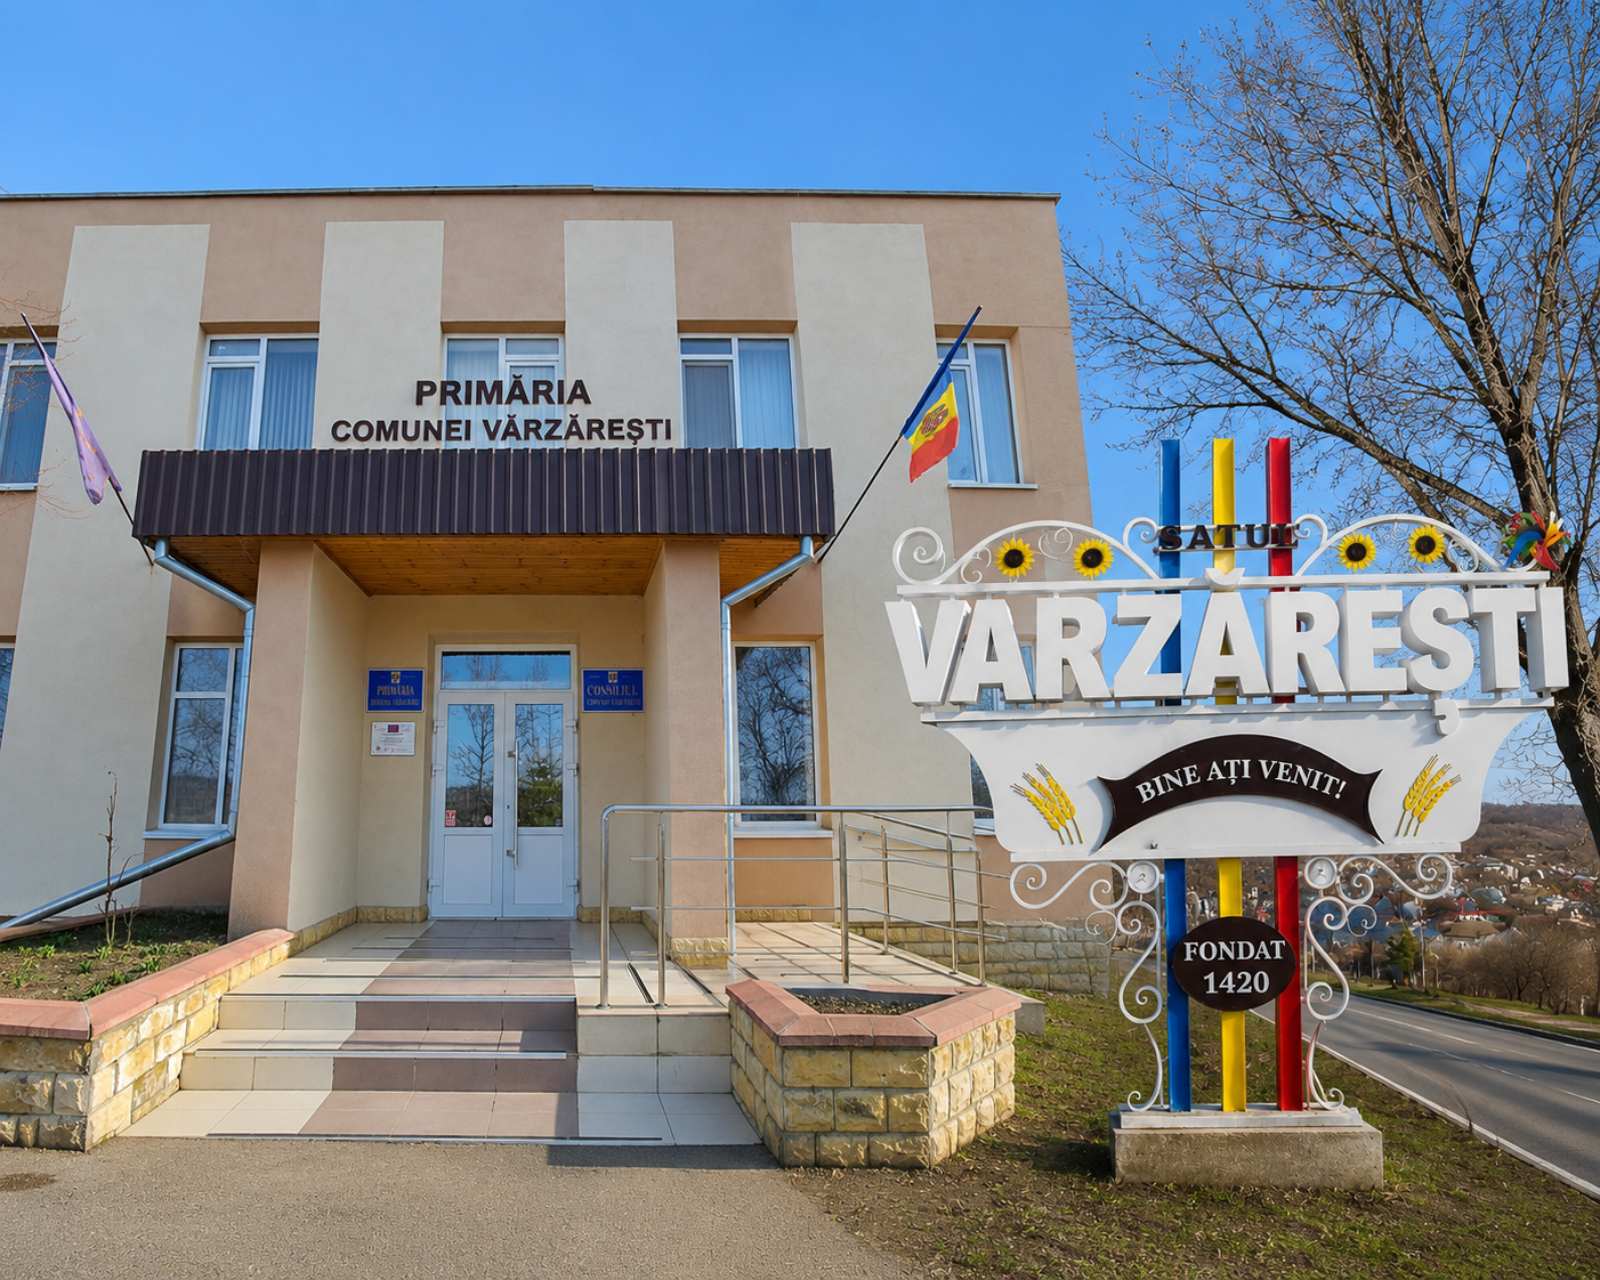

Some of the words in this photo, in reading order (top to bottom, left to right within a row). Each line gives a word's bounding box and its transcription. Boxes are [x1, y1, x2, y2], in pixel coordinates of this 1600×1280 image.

[415, 374, 591, 406] PRIMĂRIA
[331, 420, 471, 442] COMUNEI
[1159, 523, 1300, 550] SATUL
[1135, 764, 1201, 803] BINE
[1258, 759, 1347, 800] VENIT!
[1183, 940, 1286, 961] FONDAT
[1203, 970, 1270, 994] 1420
